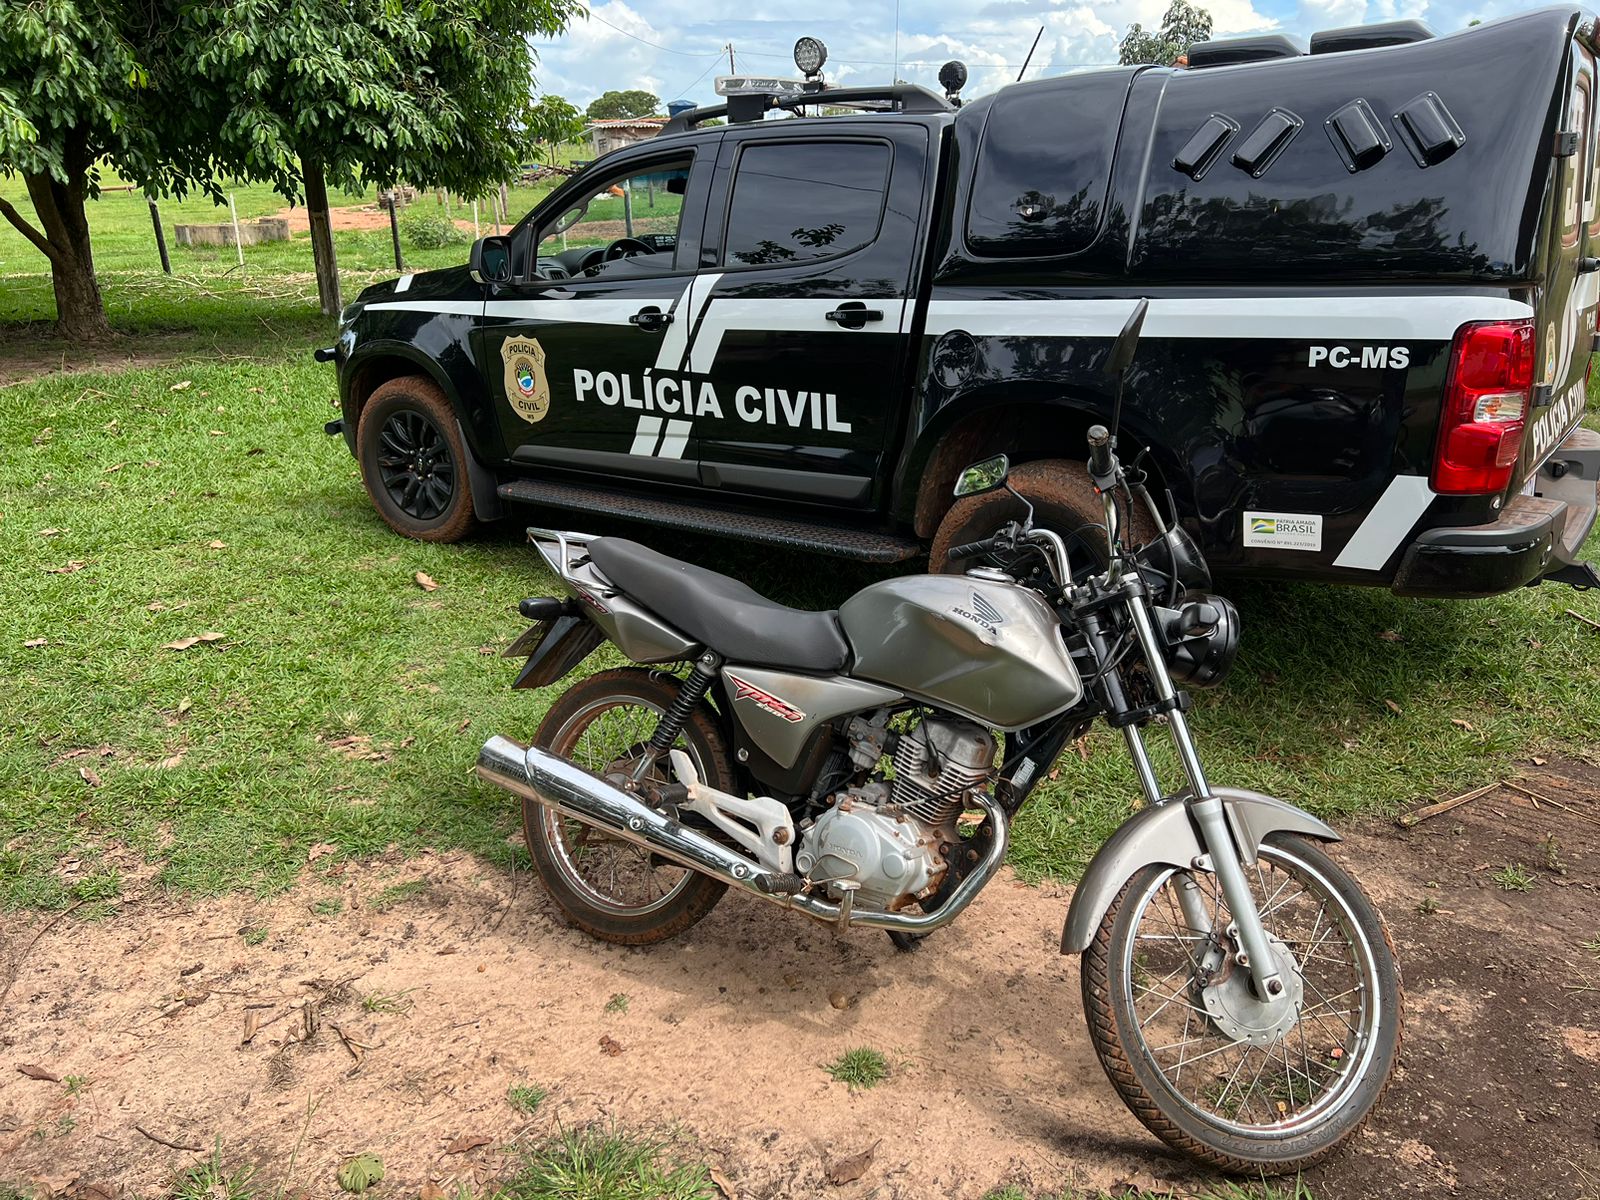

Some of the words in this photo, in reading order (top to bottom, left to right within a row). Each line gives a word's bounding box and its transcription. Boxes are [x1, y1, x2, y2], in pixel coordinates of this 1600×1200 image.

[509, 344, 536, 357] POLÍCIA
[1308, 346, 1410, 369] PC-MS
[518, 400, 541, 410] CIVIL
[573, 367, 724, 419] POLÍCIA
[735, 384, 852, 433] CIVIL
[1532, 394, 1568, 460] POLÍCIA
[1276, 524, 1316, 534] BRASIL
[952, 607, 998, 636] HONDA
